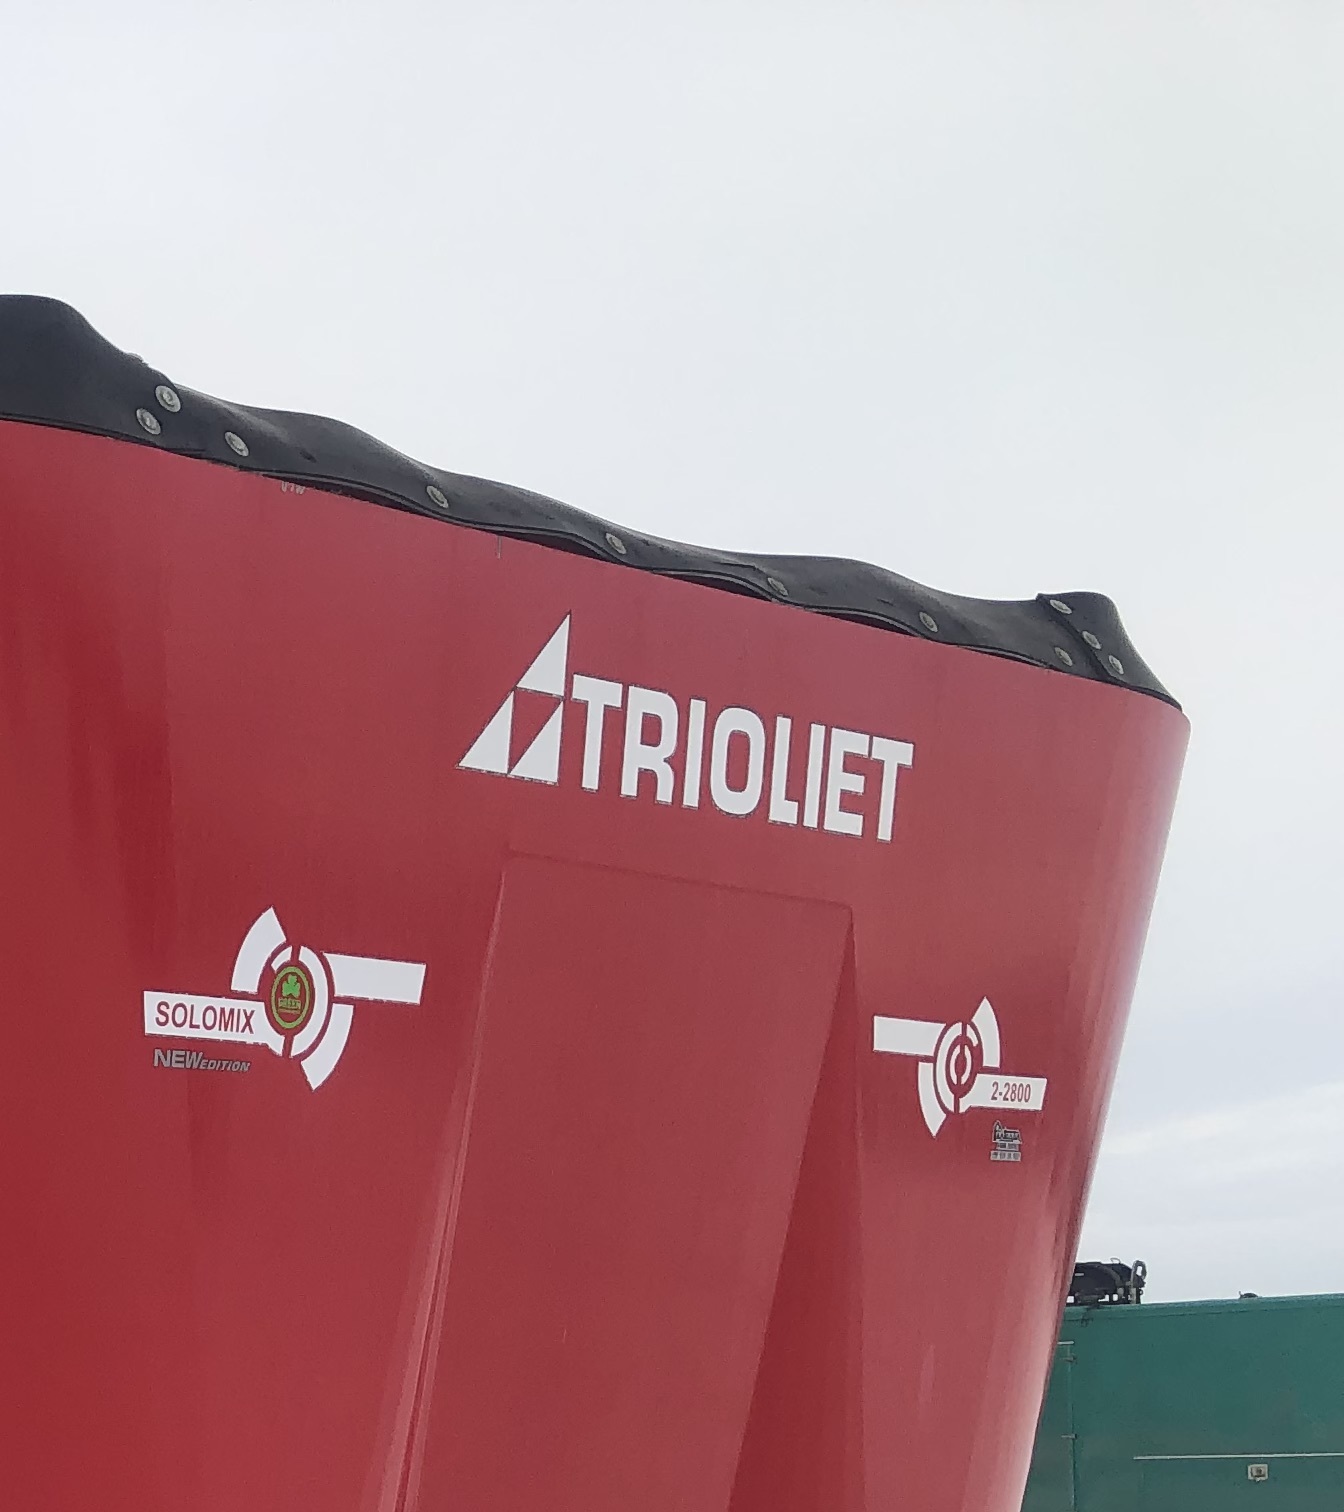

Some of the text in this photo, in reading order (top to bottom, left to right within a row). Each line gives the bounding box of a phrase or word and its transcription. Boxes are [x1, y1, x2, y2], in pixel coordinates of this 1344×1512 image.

[570, 672, 915, 843] TRIOLIET
[154, 1000, 256, 1035] SOLOMIX
[990, 1080, 1032, 1103] 2-2800
